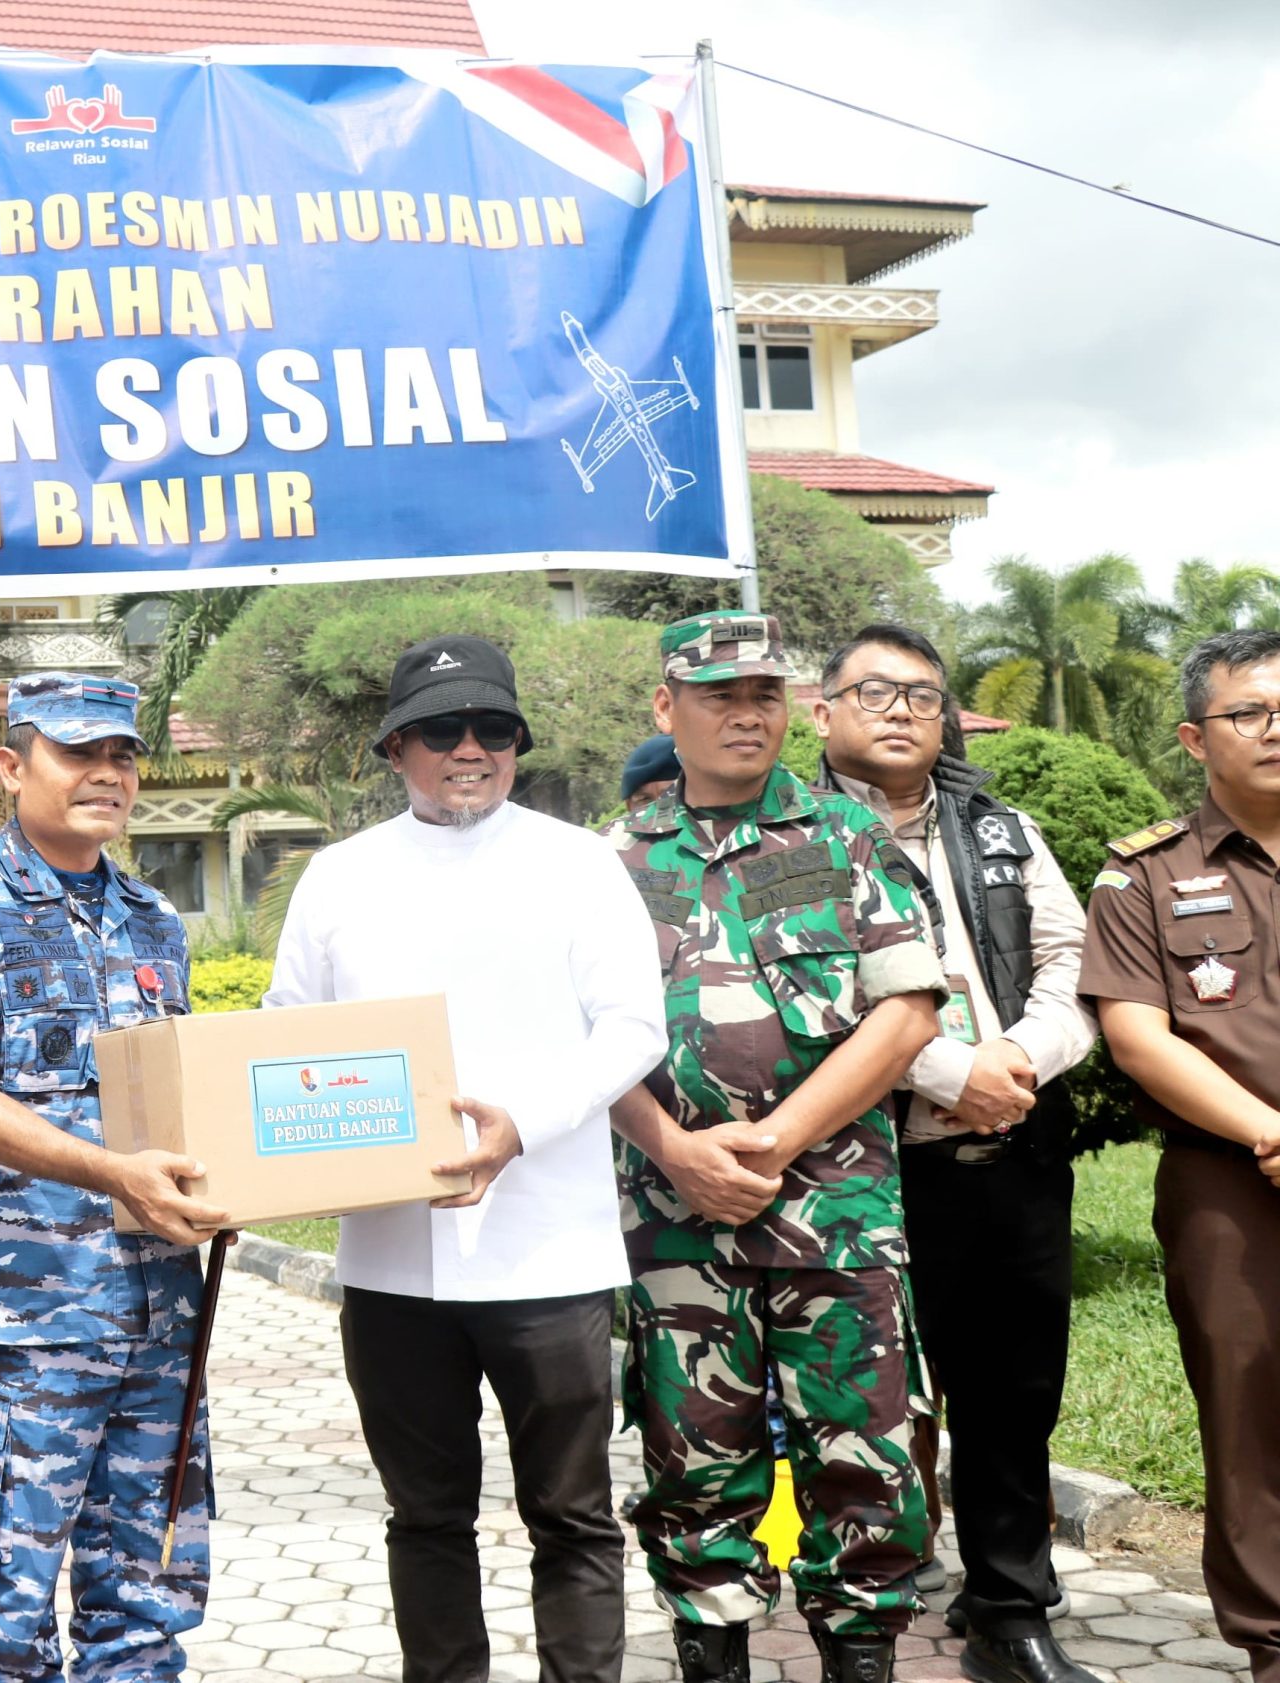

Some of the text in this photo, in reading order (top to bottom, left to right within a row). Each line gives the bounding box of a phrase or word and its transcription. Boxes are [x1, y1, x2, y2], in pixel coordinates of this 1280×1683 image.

[25, 136, 149, 153] Relawan Sosial
[73, 153, 106, 165] Riau
[296, 190, 585, 250] NURJADIN
[95, 347, 507, 462] SOSIAL
[32, 471, 316, 548] BANJIR
[263, 1096, 405, 1123] BANTUAN SOSIAL
[273, 1117, 400, 1144] PEDULI BANJIR
